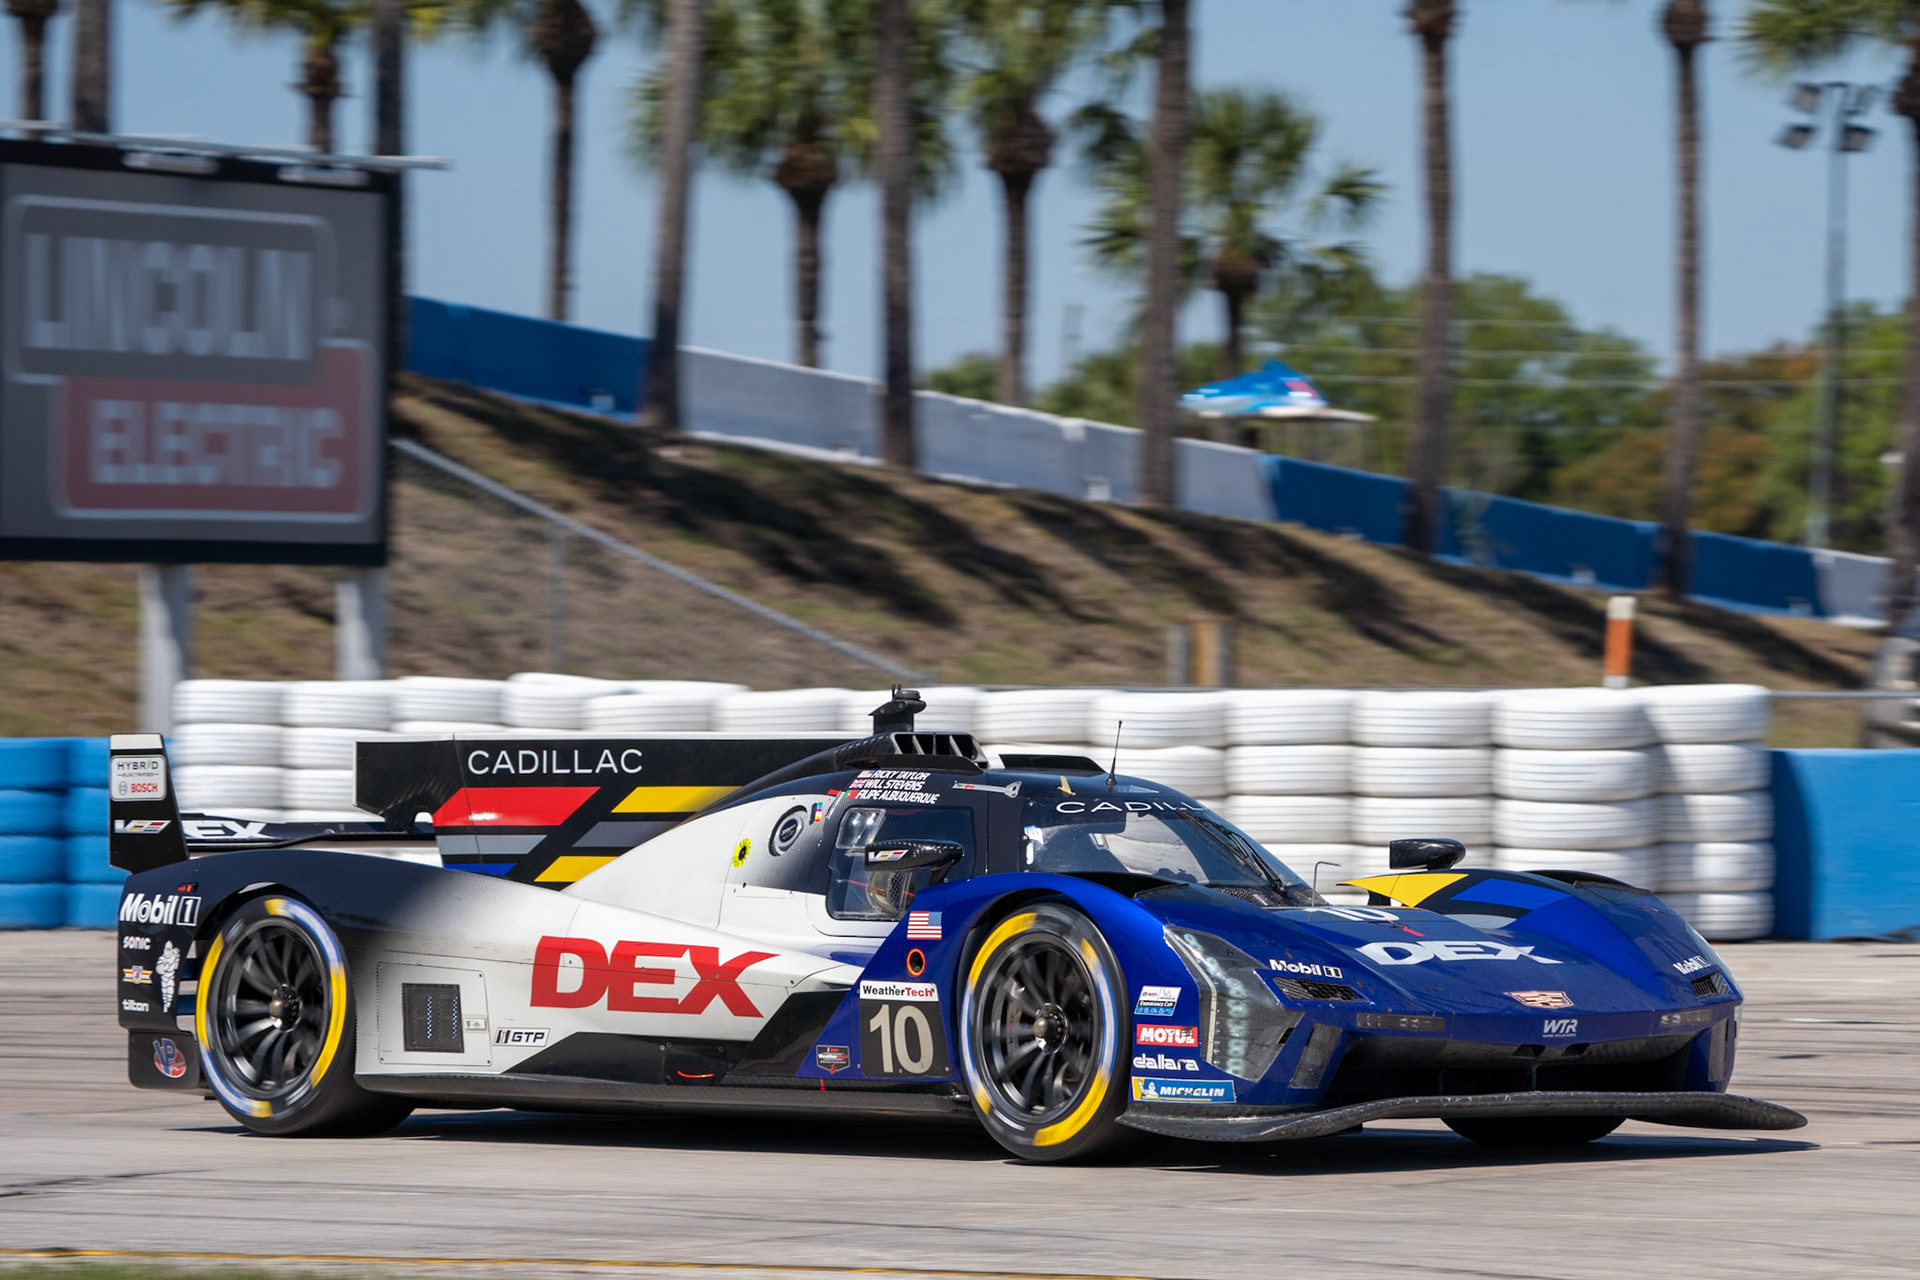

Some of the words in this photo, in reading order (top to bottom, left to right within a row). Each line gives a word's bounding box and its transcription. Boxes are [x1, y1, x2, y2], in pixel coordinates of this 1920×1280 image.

[25, 233, 313, 360] LINCOLN
[90, 399, 342, 489] ELECTRIC
[117, 760, 159, 770] HYBRID
[467, 748, 643, 775] CADILLAC
[871, 770, 897, 779] RICKY
[896, 771, 931, 780] TAYLOR
[130, 783, 158, 793] BOSCH
[864, 779, 885, 789] WILL
[883, 780, 925, 791] STEVENS
[879, 790, 940, 804] ALBUQUERQUE
[1056, 801, 1209, 814] CADILL
[181, 820, 276, 839] EX
[120, 893, 179, 924] Mobil
[1355, 940, 1564, 965] DEX
[1269, 959, 1322, 976] Mobil
[1673, 957, 1704, 975] Mobil
[530, 935, 782, 1018] DEX
[863, 985, 933, 997] WeatherTech
[1543, 1019, 1578, 1034] WTR
[511, 1032, 545, 1043] GTP
[869, 1004, 934, 1074] 10
[1140, 1027, 1195, 1044] MOTUL
[153, 1038, 177, 1076] VP
[1133, 1053, 1200, 1071] dallara
[1160, 1086, 1225, 1097] MICHELIN
